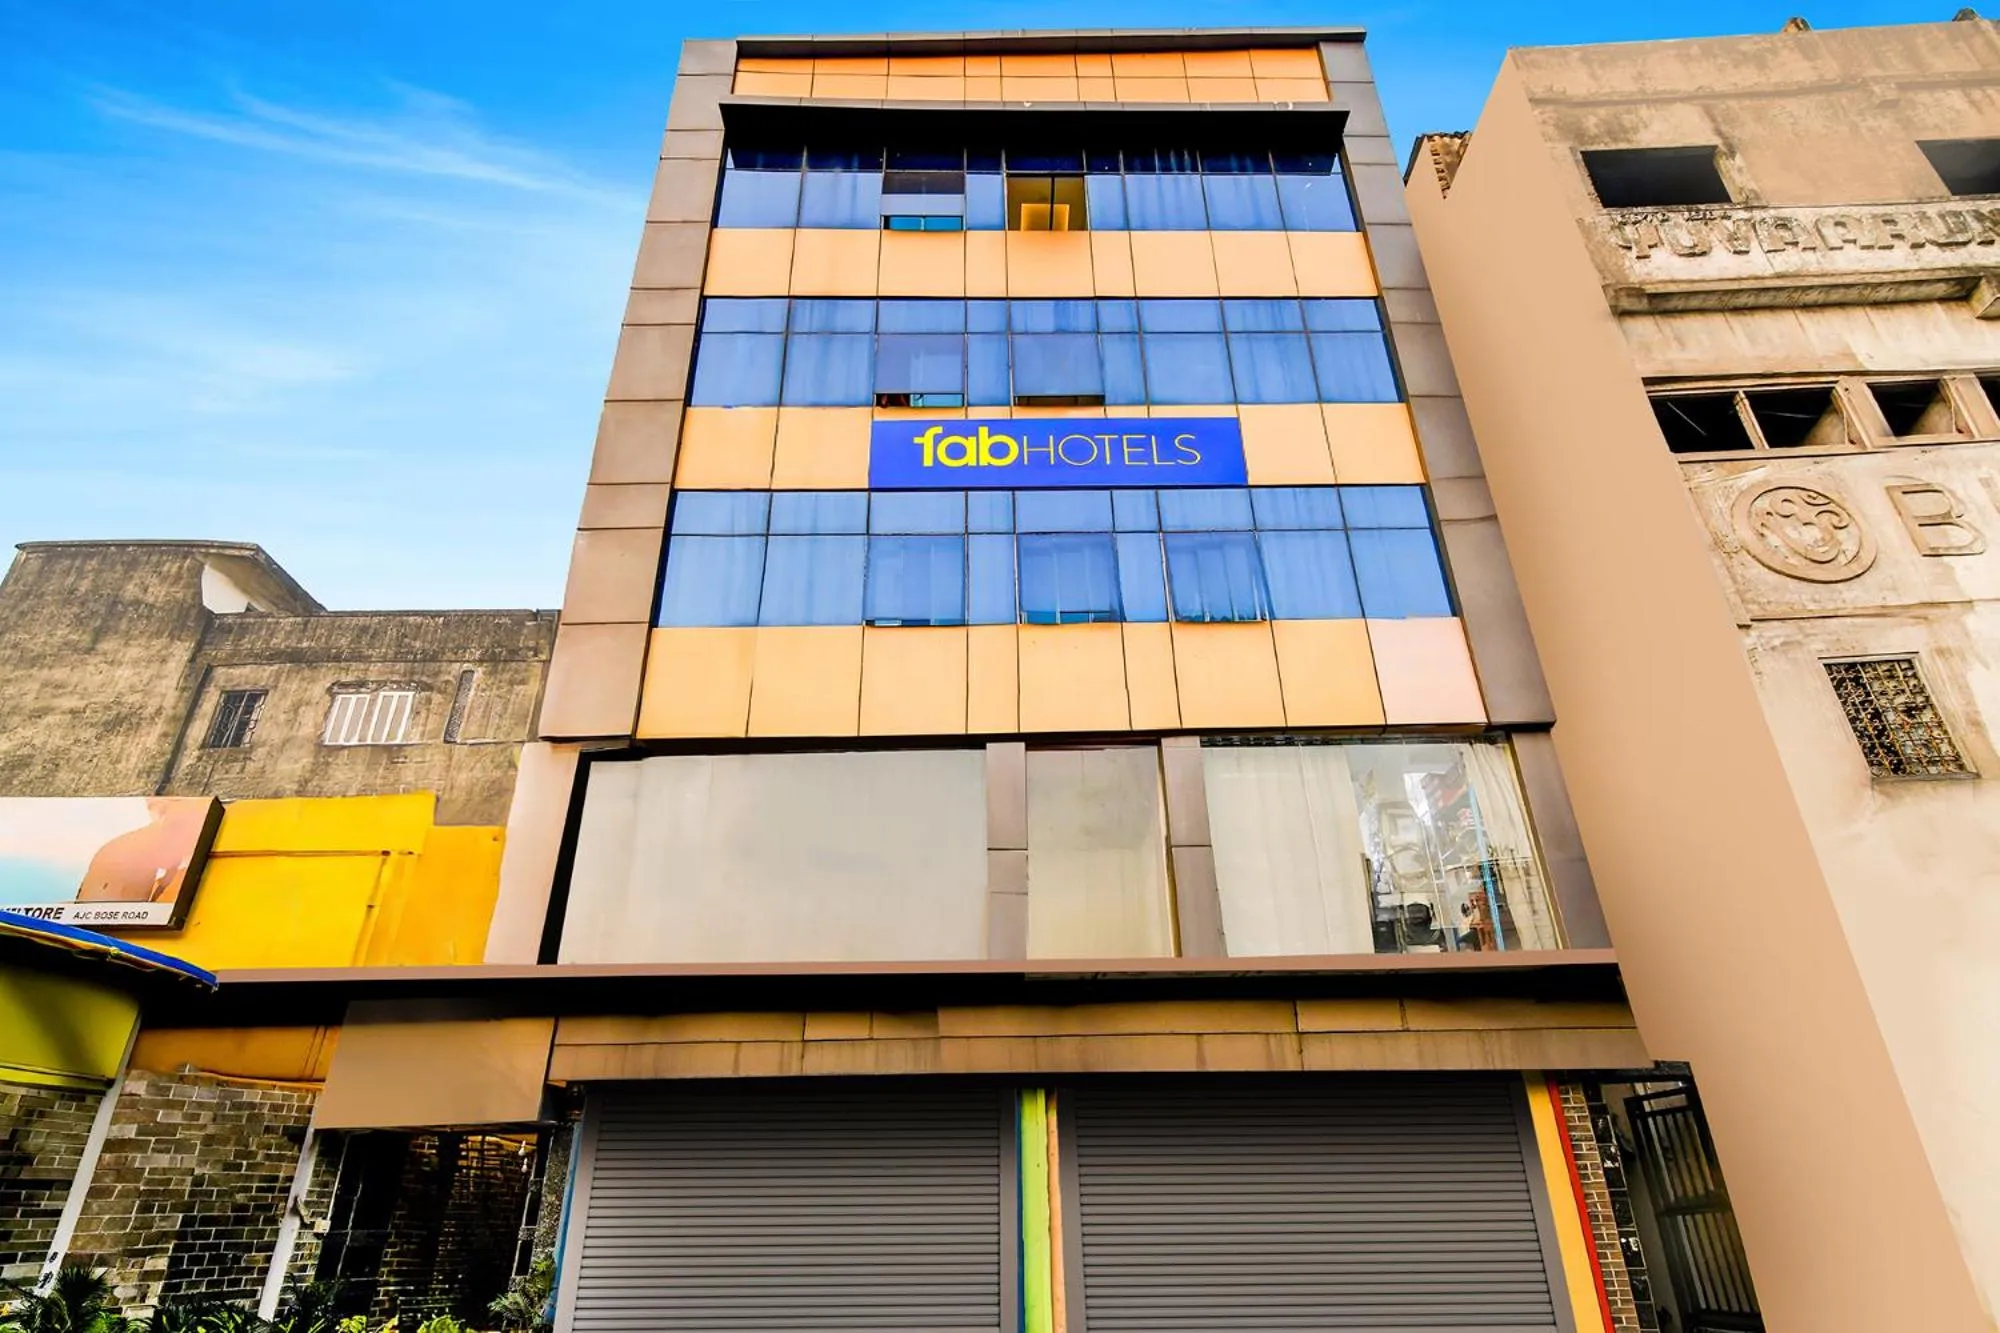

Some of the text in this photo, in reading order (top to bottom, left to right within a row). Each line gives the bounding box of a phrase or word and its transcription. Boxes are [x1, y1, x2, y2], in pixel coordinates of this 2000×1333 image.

[73, 911, 92, 920] AJC
[93, 911, 119, 920] BOSE
[121, 911, 149, 920] ROAD
